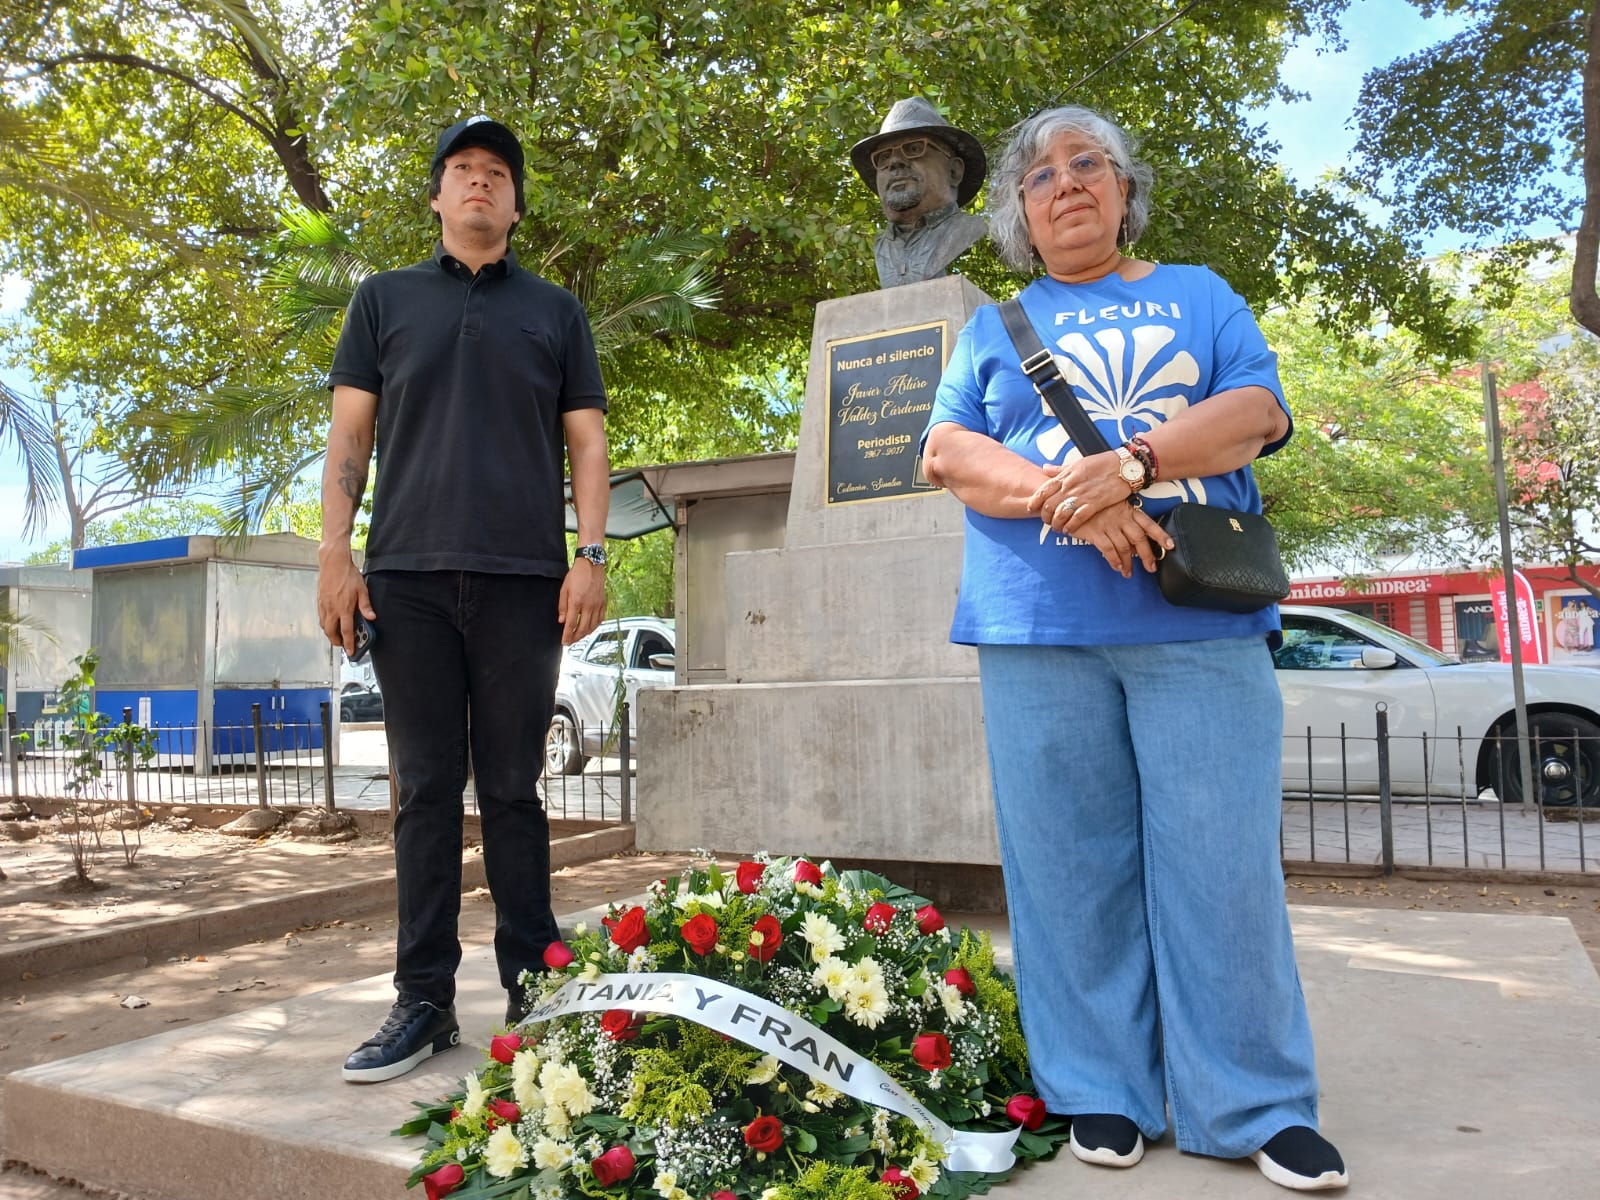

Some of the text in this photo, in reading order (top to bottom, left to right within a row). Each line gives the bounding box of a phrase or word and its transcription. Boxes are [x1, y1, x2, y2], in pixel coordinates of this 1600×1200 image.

[1054, 300, 1182, 326] FLEURI
[836, 345, 935, 372] Nunca el silencio
[842, 382, 880, 407] Javier
[837, 400, 932, 427] Valdez Cárdenas
[857, 434, 911, 450] Periodista
[1055, 536, 1069, 546] LA
[576, 982, 674, 1003] TANIA
[695, 987, 723, 1011] Y
[730, 1003, 855, 1082] FRAN
